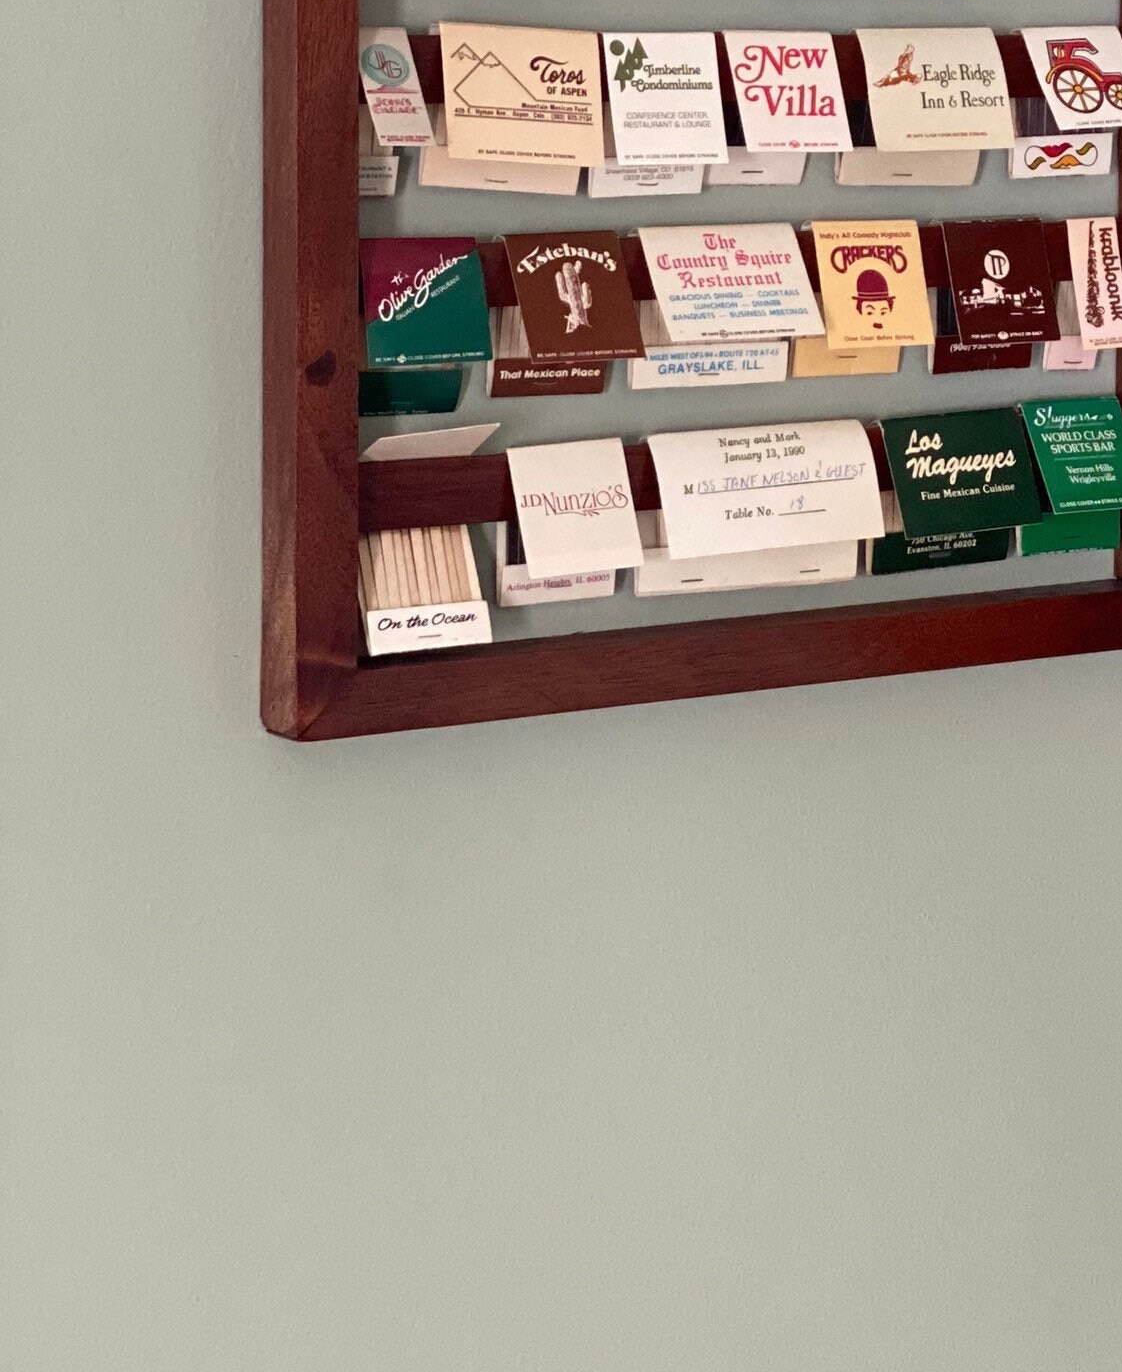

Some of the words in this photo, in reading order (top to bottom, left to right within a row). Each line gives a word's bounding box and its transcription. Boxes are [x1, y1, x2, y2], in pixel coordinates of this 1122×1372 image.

[530, 56, 586, 85] Toros
[643, 64, 701, 78] Timberline
[734, 45, 828, 84] New
[921, 63, 957, 88] Eagle
[958, 63, 996, 87] Ridge
[546, 87, 556, 95] OF
[561, 87, 587, 97] ASPEN
[631, 79, 713, 93] Condominiums
[744, 84, 837, 117] Villa
[921, 91, 945, 109] Inn
[949, 95, 957, 108] &
[959, 90, 1005, 108] Resort
[626, 111, 677, 120] CONFERENCE
[678, 111, 708, 120] CENTER
[623, 120, 673, 129] RESTAURANT
[682, 120, 712, 129] LOUNGE
[702, 233, 737, 251] The
[819, 232, 841, 241] Indy's
[852, 231, 879, 239] Comedy
[516, 243, 617, 275] Esteban's
[656, 253, 729, 271] Country
[734, 249, 792, 269] Squire
[830, 244, 908, 274] CRACKERS
[378, 286, 415, 321] Olive
[414, 254, 468, 308] Garden
[430, 275, 460, 297] RESTAURANT
[677, 271, 783, 289] Restaurant
[669, 293, 712, 302] GRACIOUS
[713, 291, 743, 300] DINING
[757, 288, 800, 297] COCKTAILS
[694, 302, 738, 310] LUNCHEON
[751, 299, 782, 308] DINNER
[672, 312, 716, 321] BANQUETS
[729, 310, 767, 318] BUSINESS
[769, 308, 808, 317] MEETINGS
[500, 369, 522, 379] That
[524, 368, 568, 378] Mexican
[571, 367, 601, 377] Place
[657, 360, 737, 375] GRAYSLAKE,
[742, 359, 764, 370] ILL.
[719, 437, 750, 448] Nancy
[753, 435, 772, 444] and
[775, 432, 801, 442] Mark
[905, 429, 943, 455] Los
[1041, 431, 1082, 443] WORLD
[1084, 430, 1117, 441] CLASS
[724, 452, 763, 464] January
[765, 450, 780, 460] 13,
[784, 446, 806, 457] 1990
[1050, 443, 1093, 454] SPORTS
[1093, 442, 1116, 452] BAR
[762, 470, 810, 487] NELSON
[826, 463, 866, 477] GUEST
[906, 449, 1017, 485] Magueyes
[1066, 465, 1094, 474] Vernon
[1095, 464, 1114, 472] Hills
[1069, 474, 1117, 484] Wrigleyville
[921, 490, 941, 501] Fine
[943, 487, 980, 498] Mexican
[983, 483, 1016, 494] Cuisine
[725, 508, 753, 521] Table
[756, 506, 774, 517] No.
[953, 539, 977, 549] 60202
[507, 582, 541, 591] Arlington
[378, 618, 402, 631] On
[406, 615, 429, 629] the
[431, 612, 478, 624] Ocean
